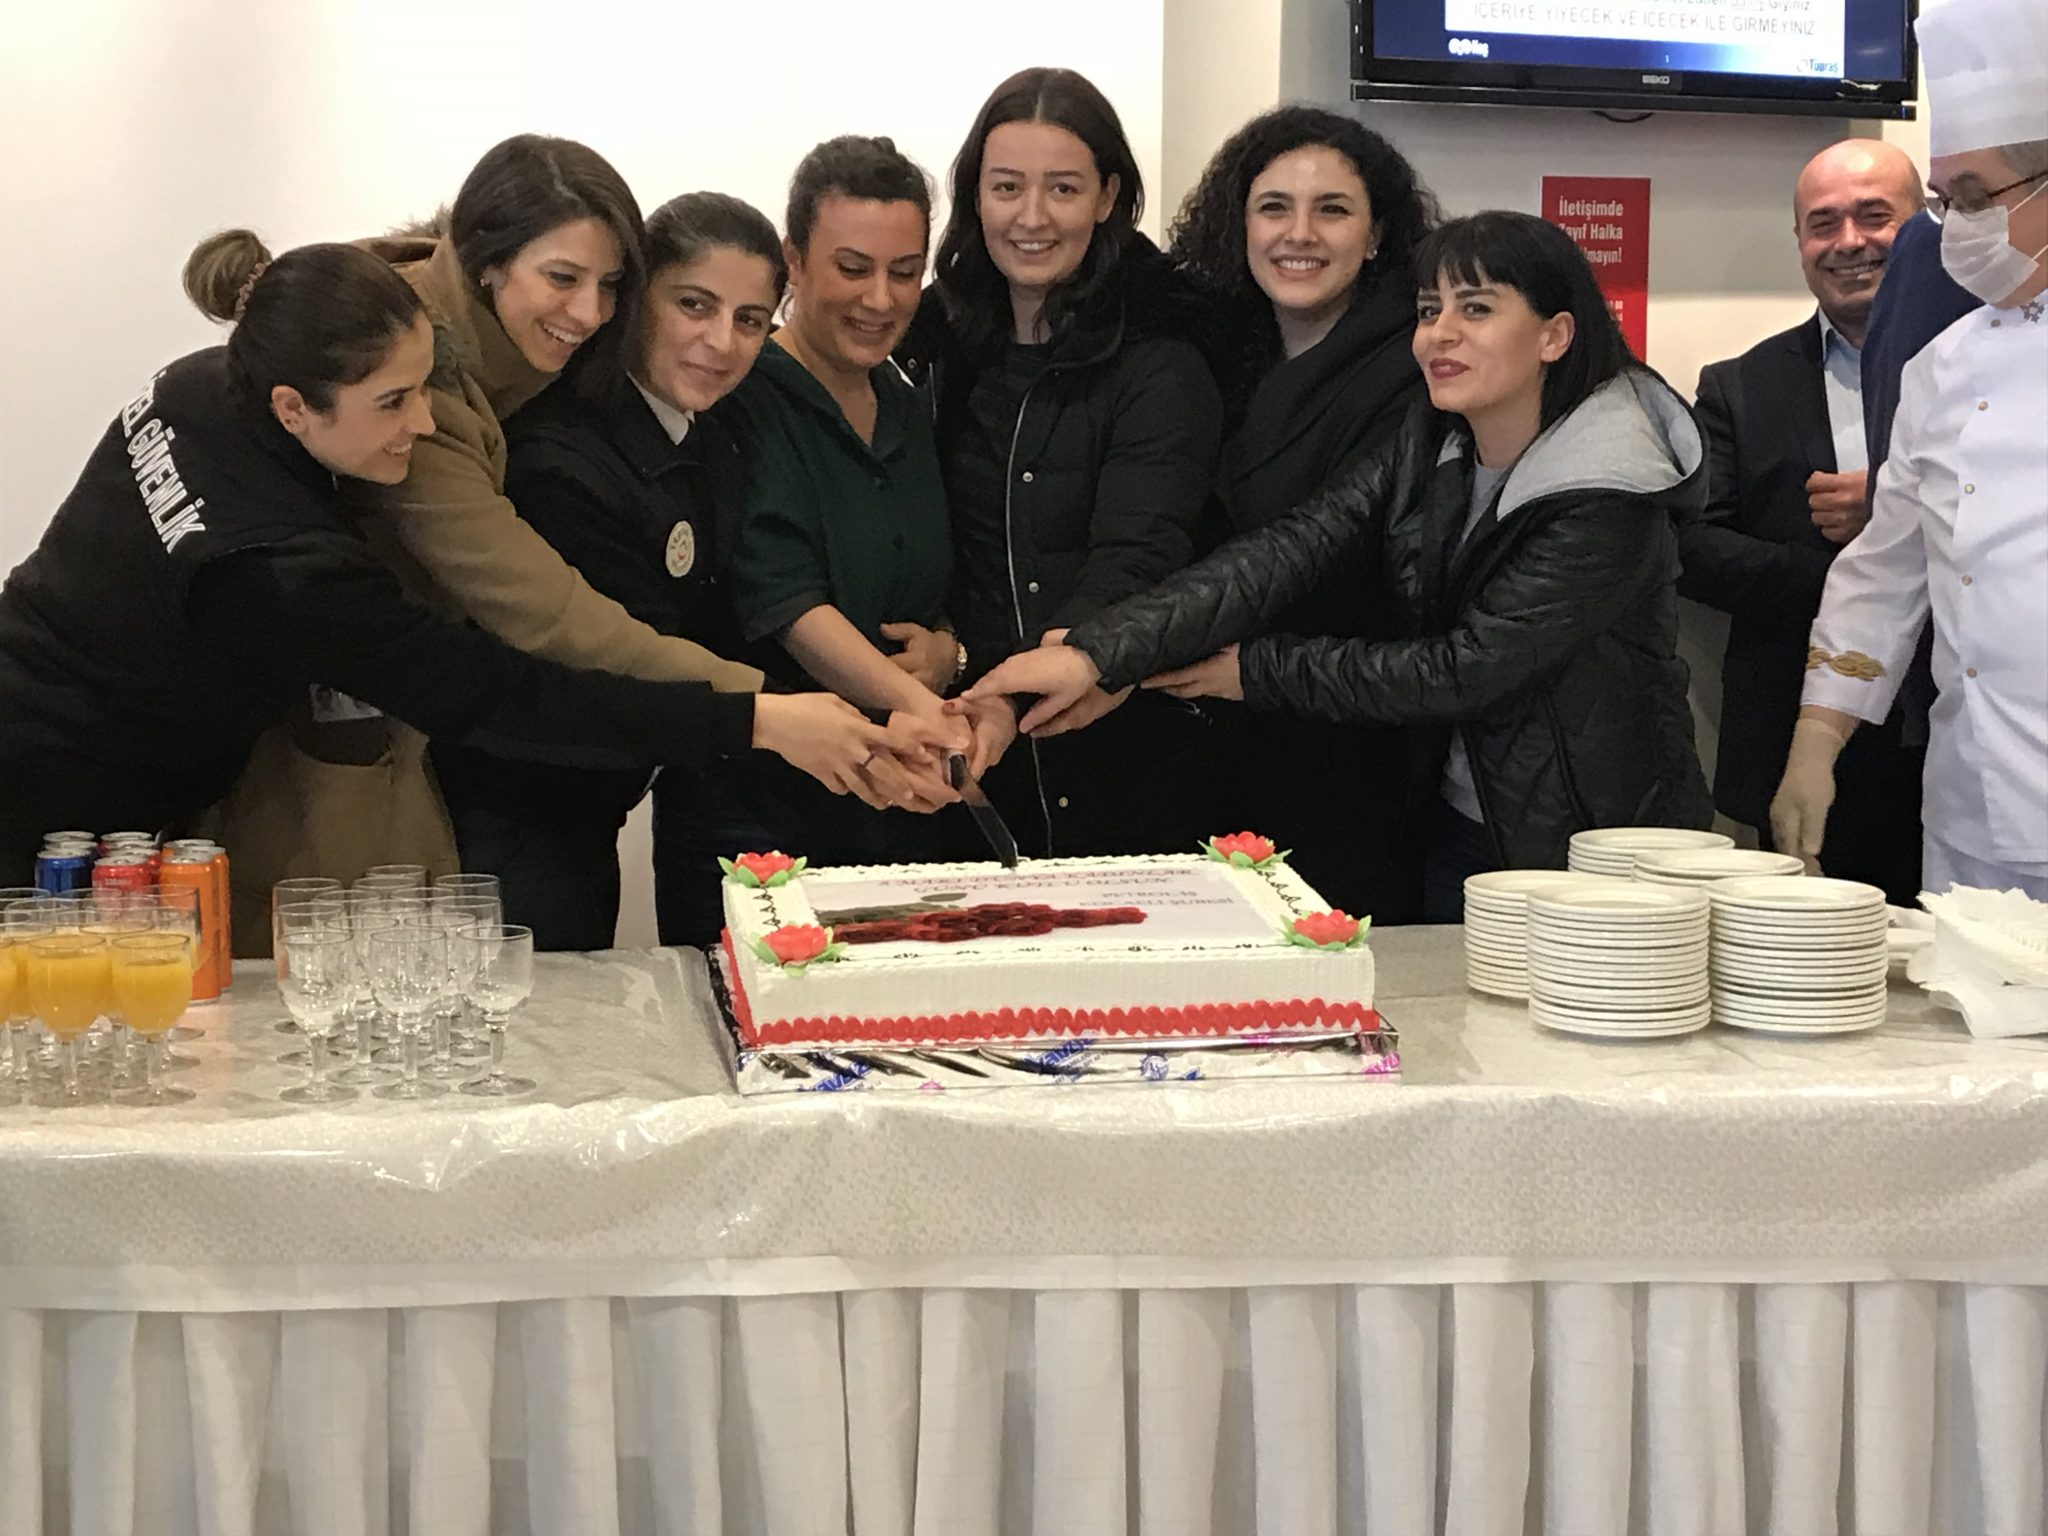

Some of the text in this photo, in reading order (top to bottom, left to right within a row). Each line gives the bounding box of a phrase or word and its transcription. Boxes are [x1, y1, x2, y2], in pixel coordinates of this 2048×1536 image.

[1618, 9, 1638, 25] VE
[1559, 195, 1624, 220] İletişimde
[1590, 223, 1623, 240] Halka
[127, 418, 206, 554] GÜVENLİK
